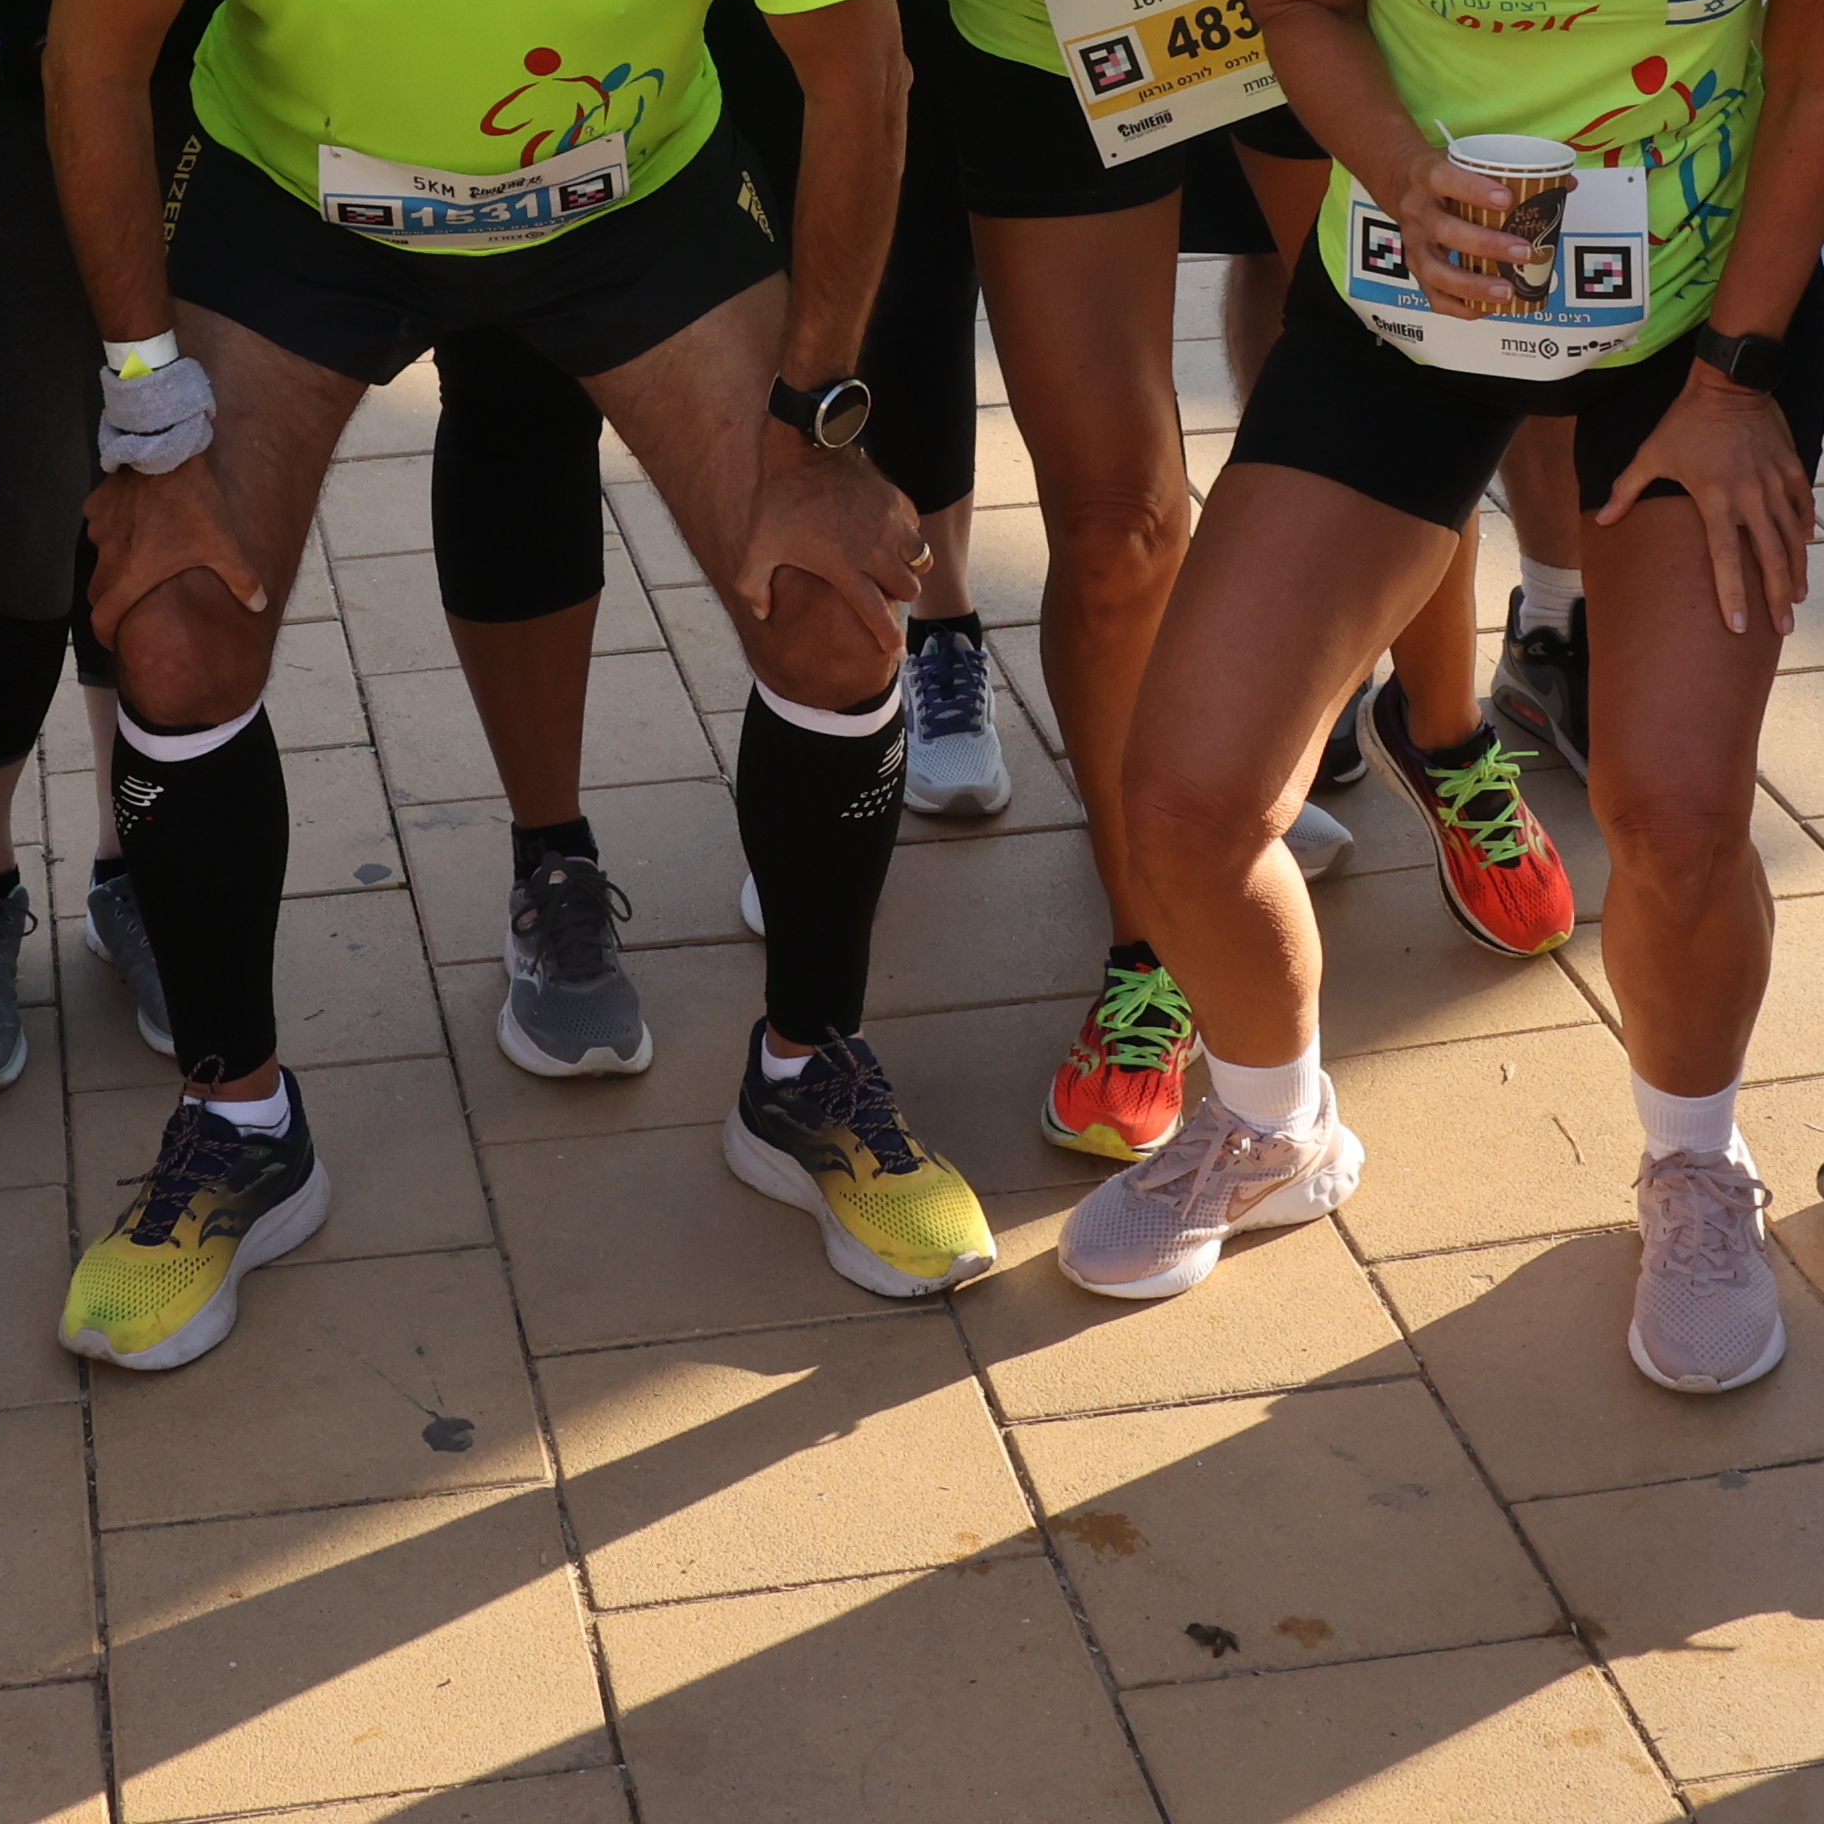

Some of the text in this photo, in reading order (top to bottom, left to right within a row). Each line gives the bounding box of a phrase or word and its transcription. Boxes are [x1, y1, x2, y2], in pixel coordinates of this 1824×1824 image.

[1138, 49, 1260, 102] לורנס לורנס גורגון
[1242, 73, 1277, 93] צמרת
[1117, 110, 1174, 139] CivilEng
[412, 175, 456, 198] 5KM
[409, 192, 548, 229] 1531
[1514, 205, 1541, 223] Hot
[1507, 220, 1548, 236] Coffee
[1533, 309, 1592, 324] רצים עם
[1373, 316, 1425, 343] CivilEng
[1501, 337, 1537, 355] צמרת
[850, 791, 894, 809] RESS
[840, 804, 888, 819] PORT
